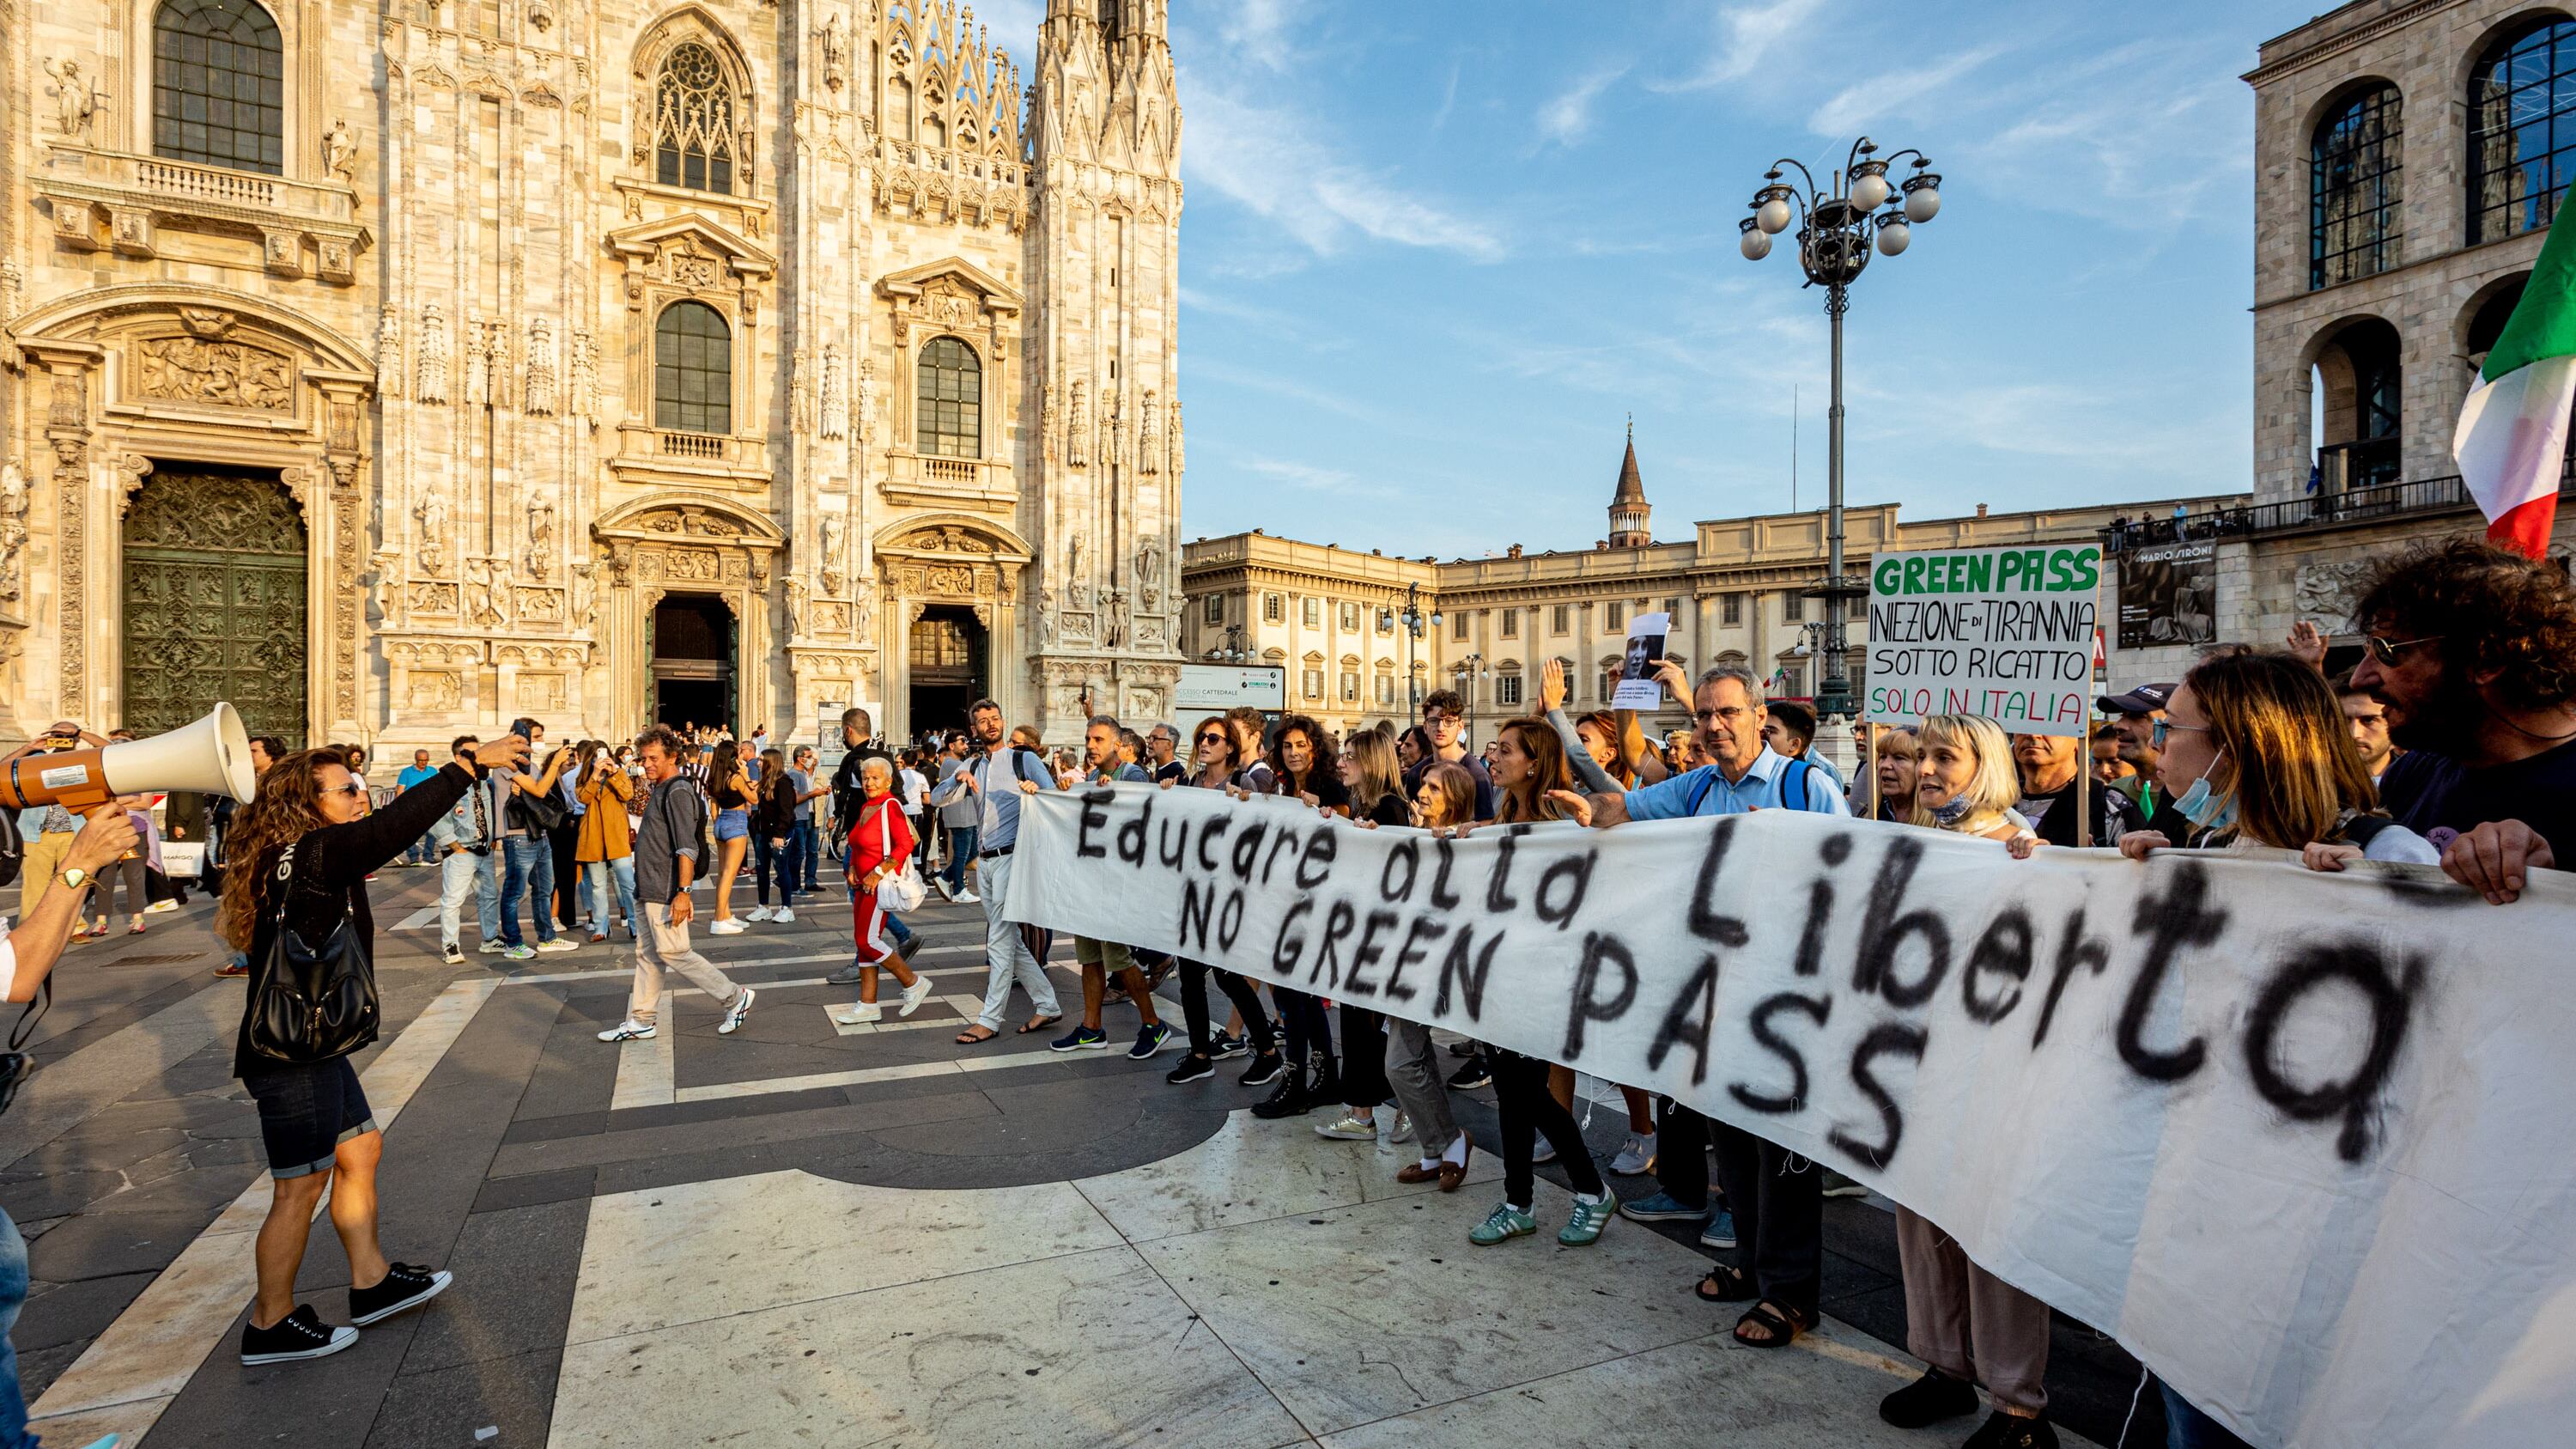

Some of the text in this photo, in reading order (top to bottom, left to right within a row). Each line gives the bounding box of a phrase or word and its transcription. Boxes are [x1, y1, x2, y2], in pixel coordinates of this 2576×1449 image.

[1874, 548, 2101, 596] GREEN PASS
[2141, 545, 2212, 563] MARIO SIRONI
[1869, 600, 2096, 642] INIEZIONE DI TIRANNIA
[1874, 648, 2086, 681] SOTTO RICATTO
[1871, 687, 2082, 724] SOLO IN ITALIA
[1077, 789, 1337, 890] Educare
[1380, 822, 1598, 931] alla
[1179, 878, 1929, 1172] NO GREEN PASS
